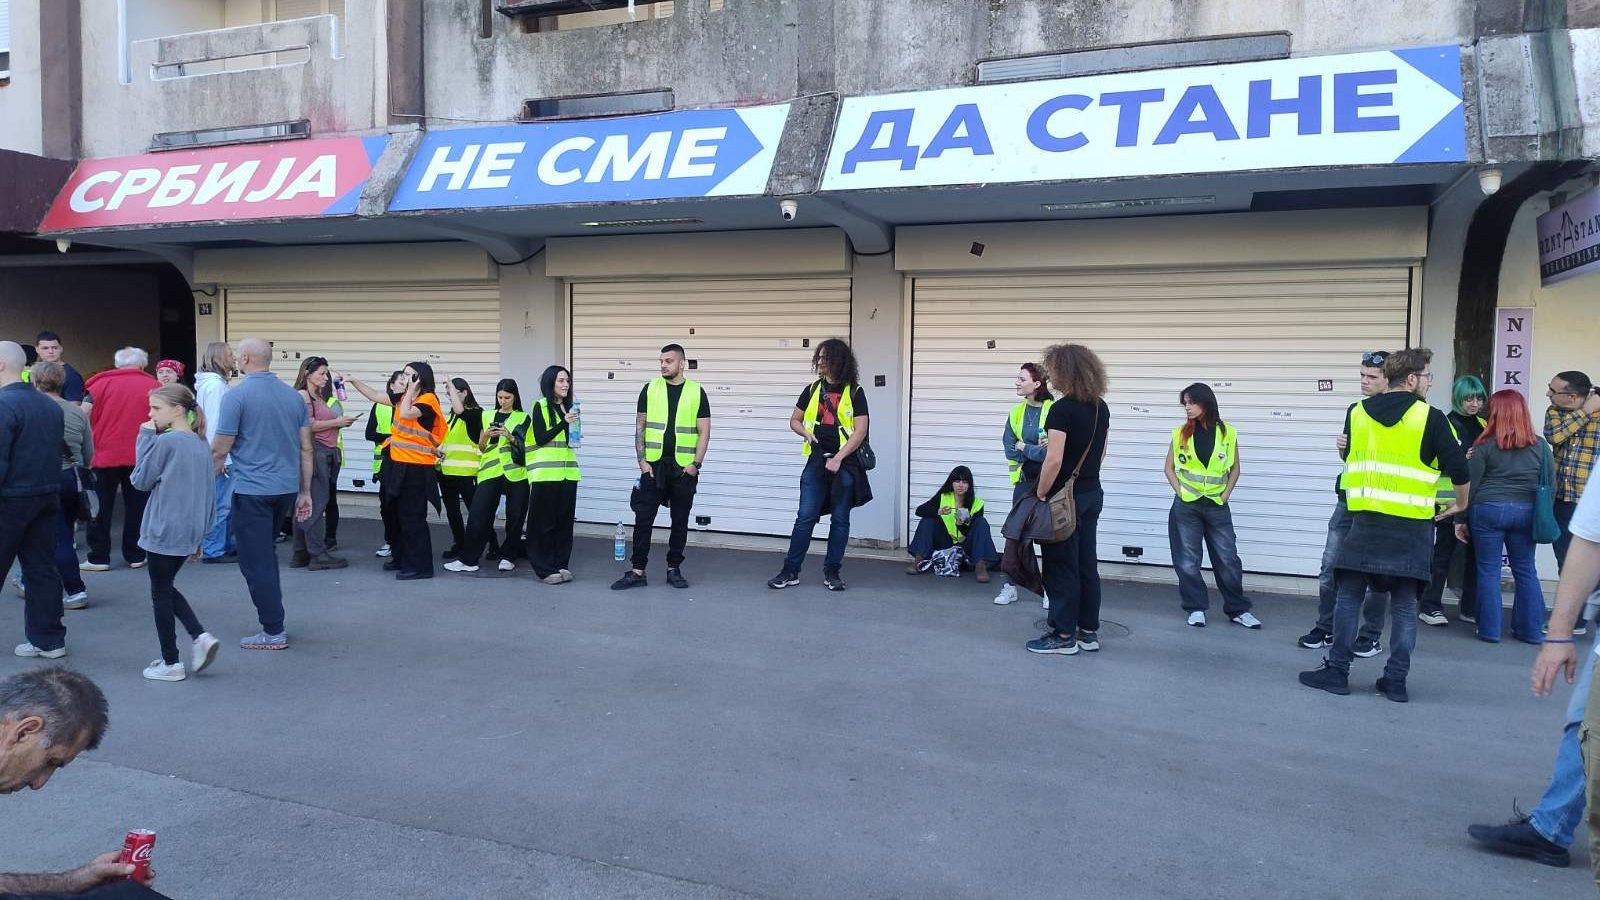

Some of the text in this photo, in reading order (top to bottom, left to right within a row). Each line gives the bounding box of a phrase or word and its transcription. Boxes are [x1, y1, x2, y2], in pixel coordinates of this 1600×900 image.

[840, 69, 1401, 174] ДА СТАНЕ
[69, 154, 338, 213] СРБИЈА
[416, 126, 728, 192] НЕ СМЕ
[1504, 317, 1524, 385] NEK
